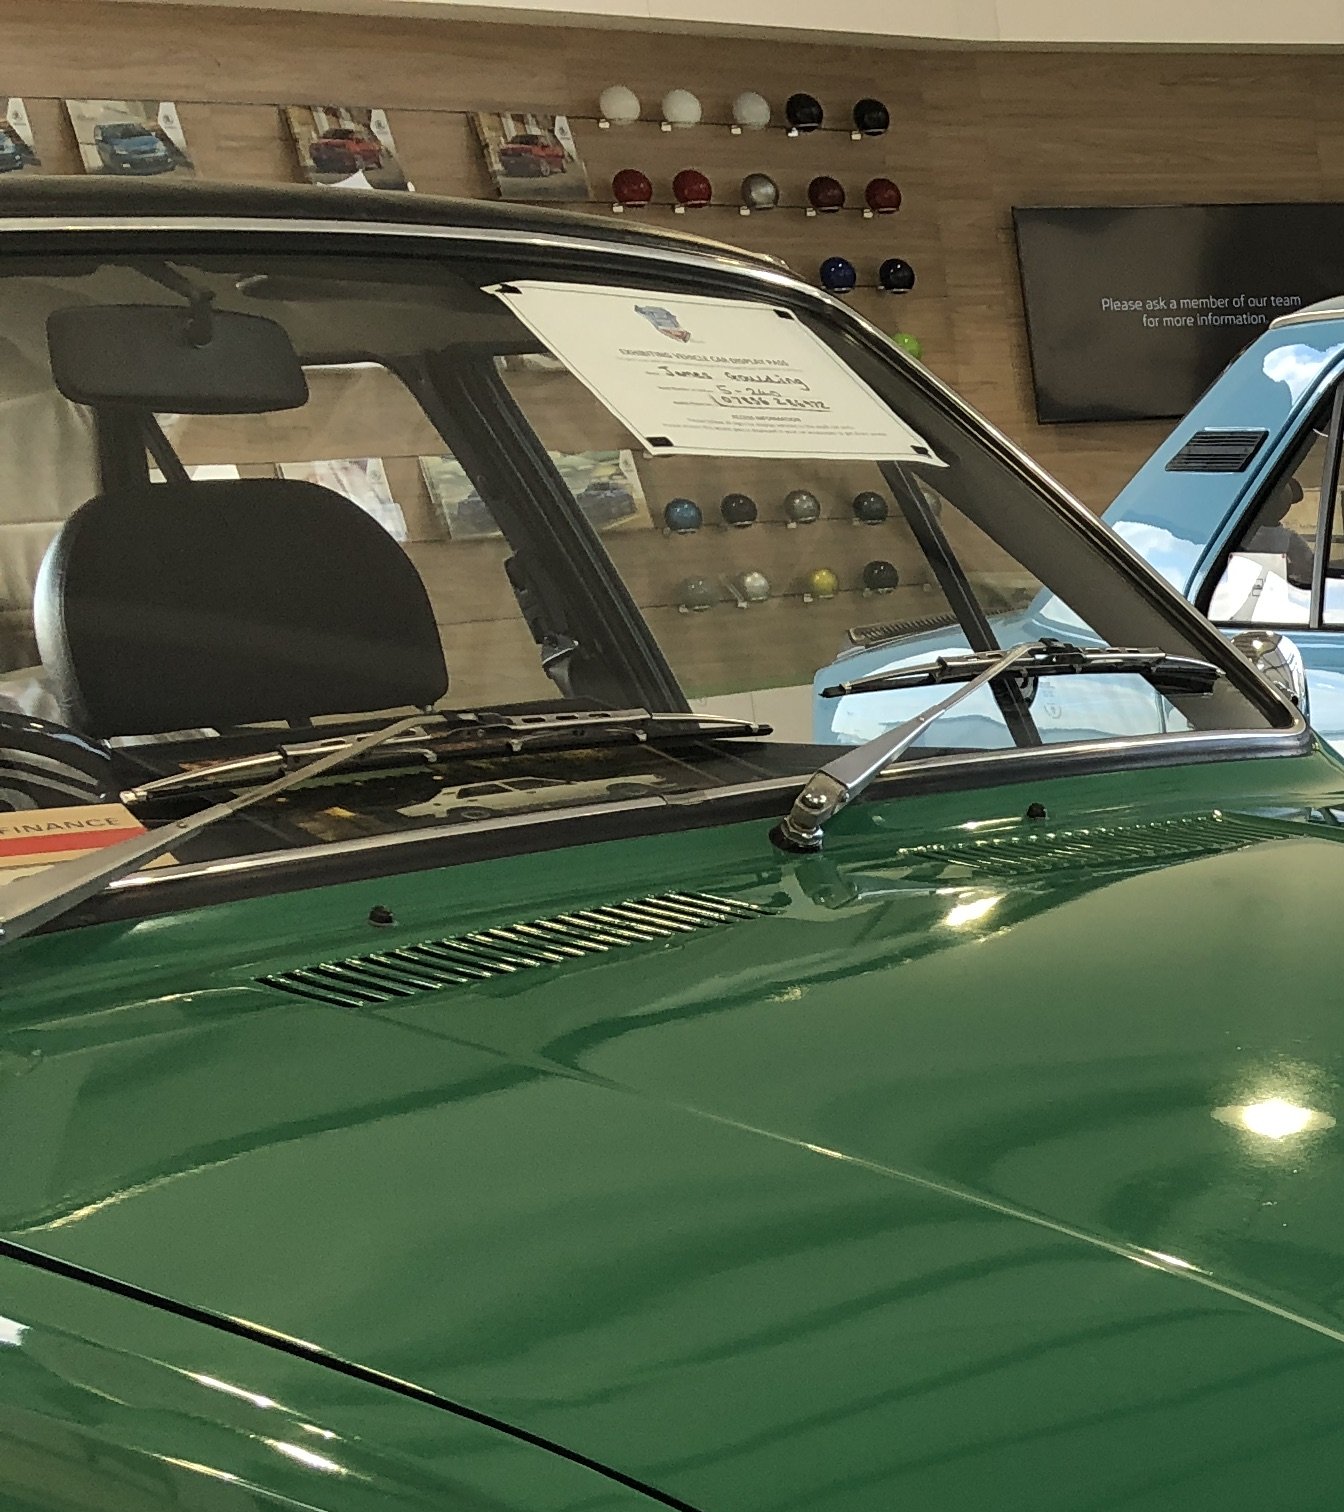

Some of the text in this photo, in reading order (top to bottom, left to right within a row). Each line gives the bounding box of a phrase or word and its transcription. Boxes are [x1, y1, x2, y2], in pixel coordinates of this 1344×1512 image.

[1101, 294, 1301, 312] Please ask a member of our team
[1142, 312, 1269, 327] for more information.
